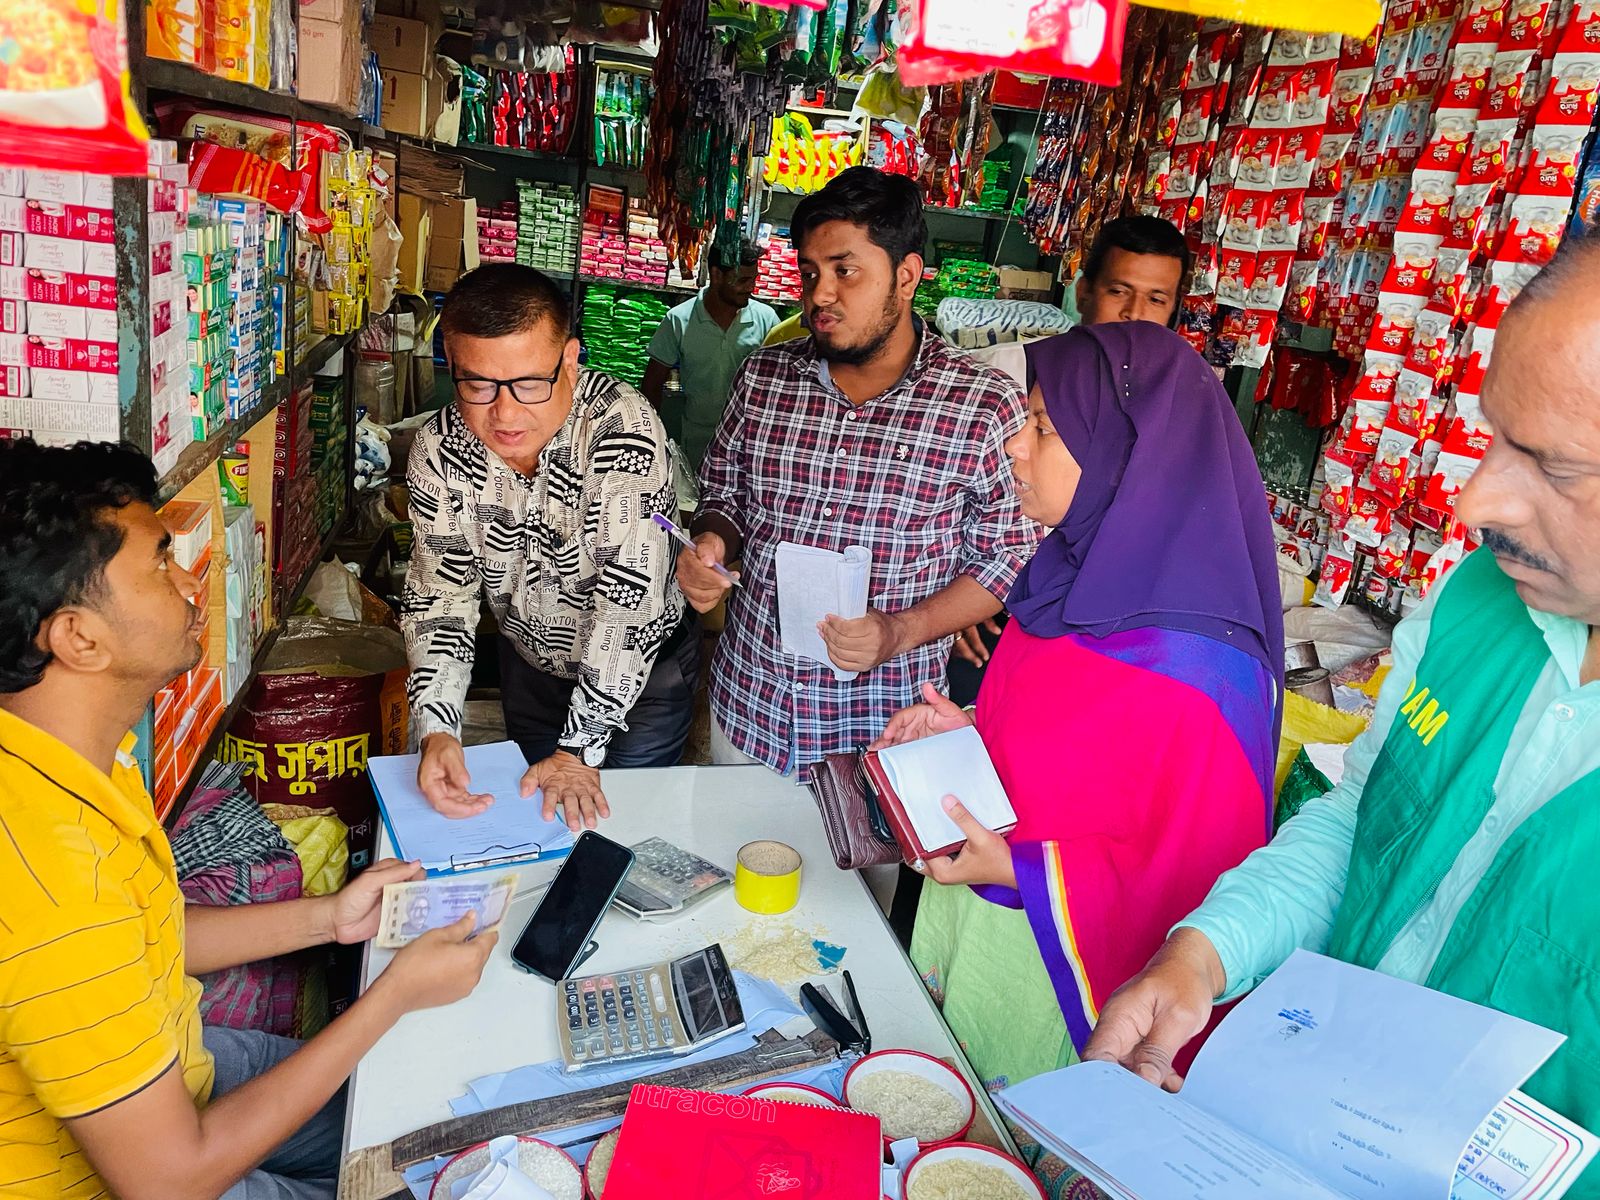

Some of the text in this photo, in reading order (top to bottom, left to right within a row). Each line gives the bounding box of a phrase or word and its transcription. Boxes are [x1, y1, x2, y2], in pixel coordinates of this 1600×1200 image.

[1559, 102, 1579, 110] Auro
[1539, 174, 1558, 183] Auro
[1414, 214, 1432, 222] Auro
[1383, 336, 1401, 344] Auro
[639, 406, 653, 435] JUST
[640, 542, 650, 571] JUST
[618, 673, 632, 699] JUST
[275, 732, 371, 795] সুপার
